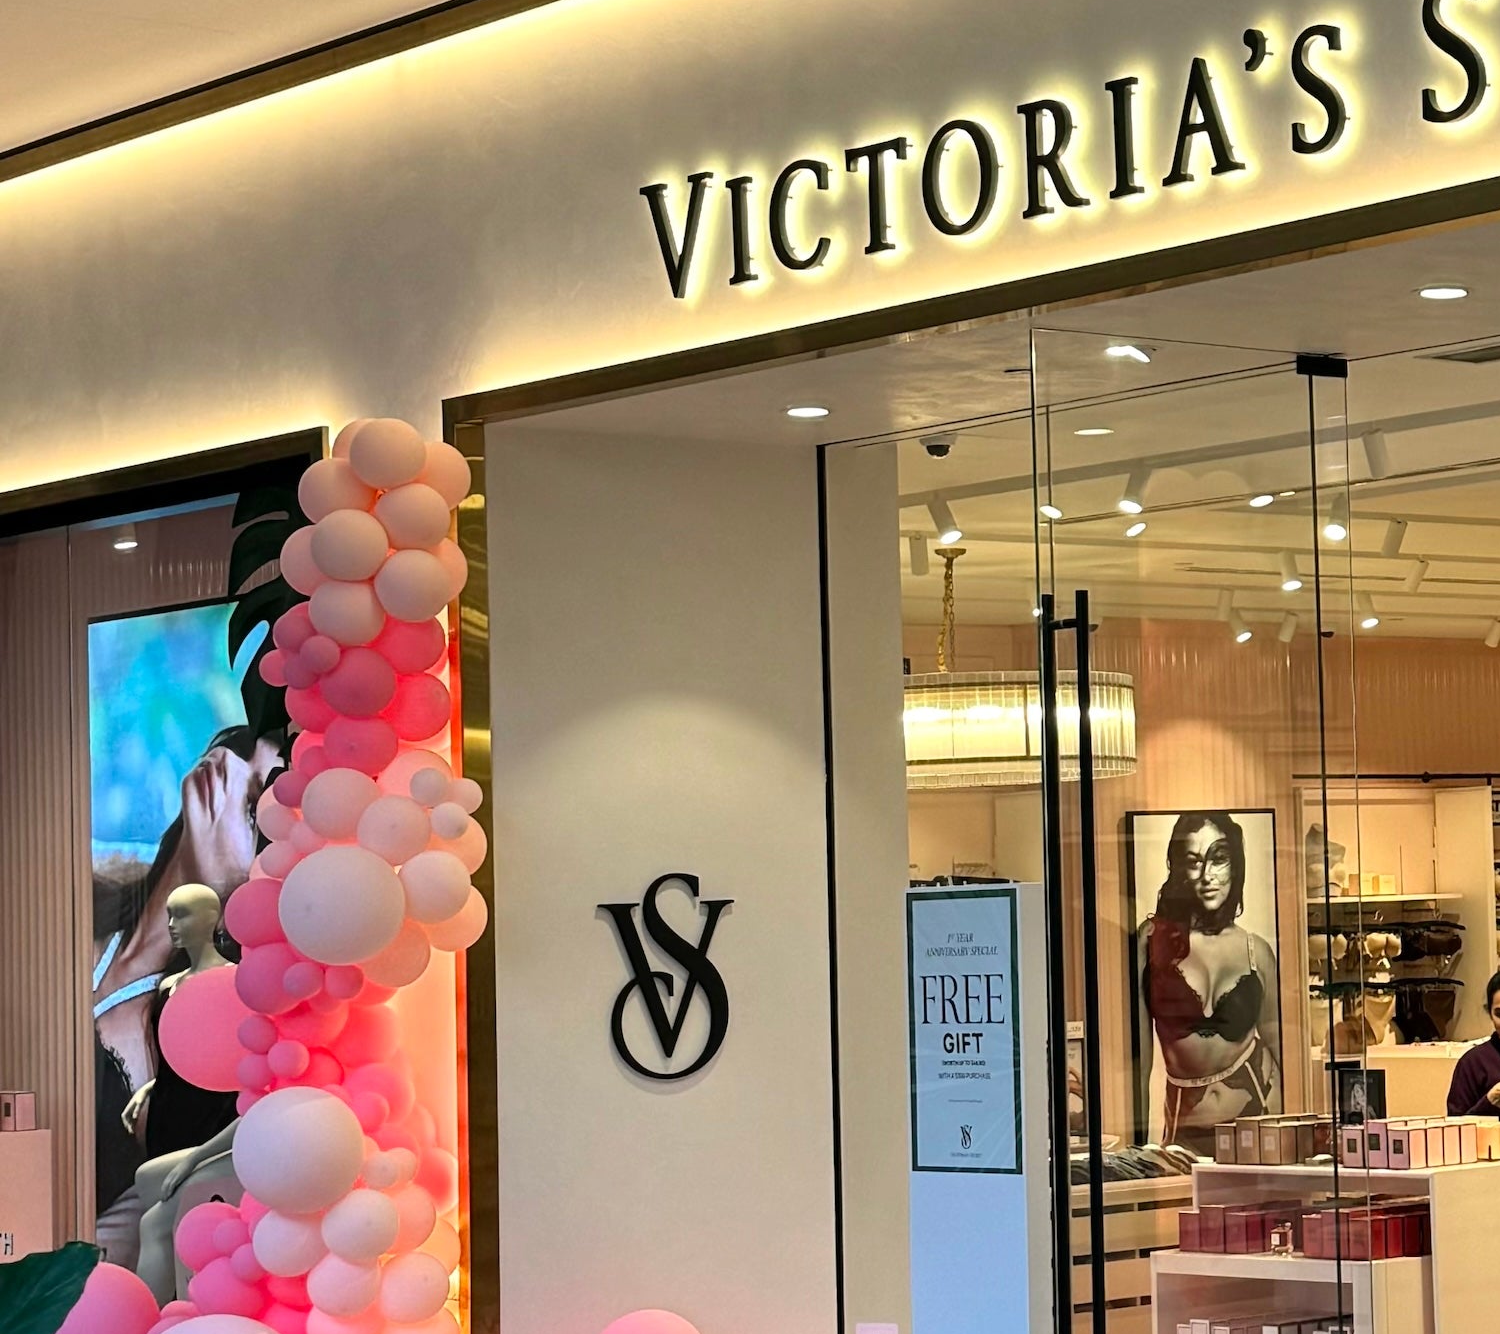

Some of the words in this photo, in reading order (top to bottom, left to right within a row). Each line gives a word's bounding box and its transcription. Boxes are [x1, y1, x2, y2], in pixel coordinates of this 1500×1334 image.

[639, 22, 1350, 299] VICTORIA'S
[957, 932, 974, 943] YEAR
[926, 946, 968, 957] ANNIVERSARY
[970, 945, 999, 956] SPECIAL
[919, 973, 1006, 1025] FREE
[943, 1032, 984, 1054] GIFT
